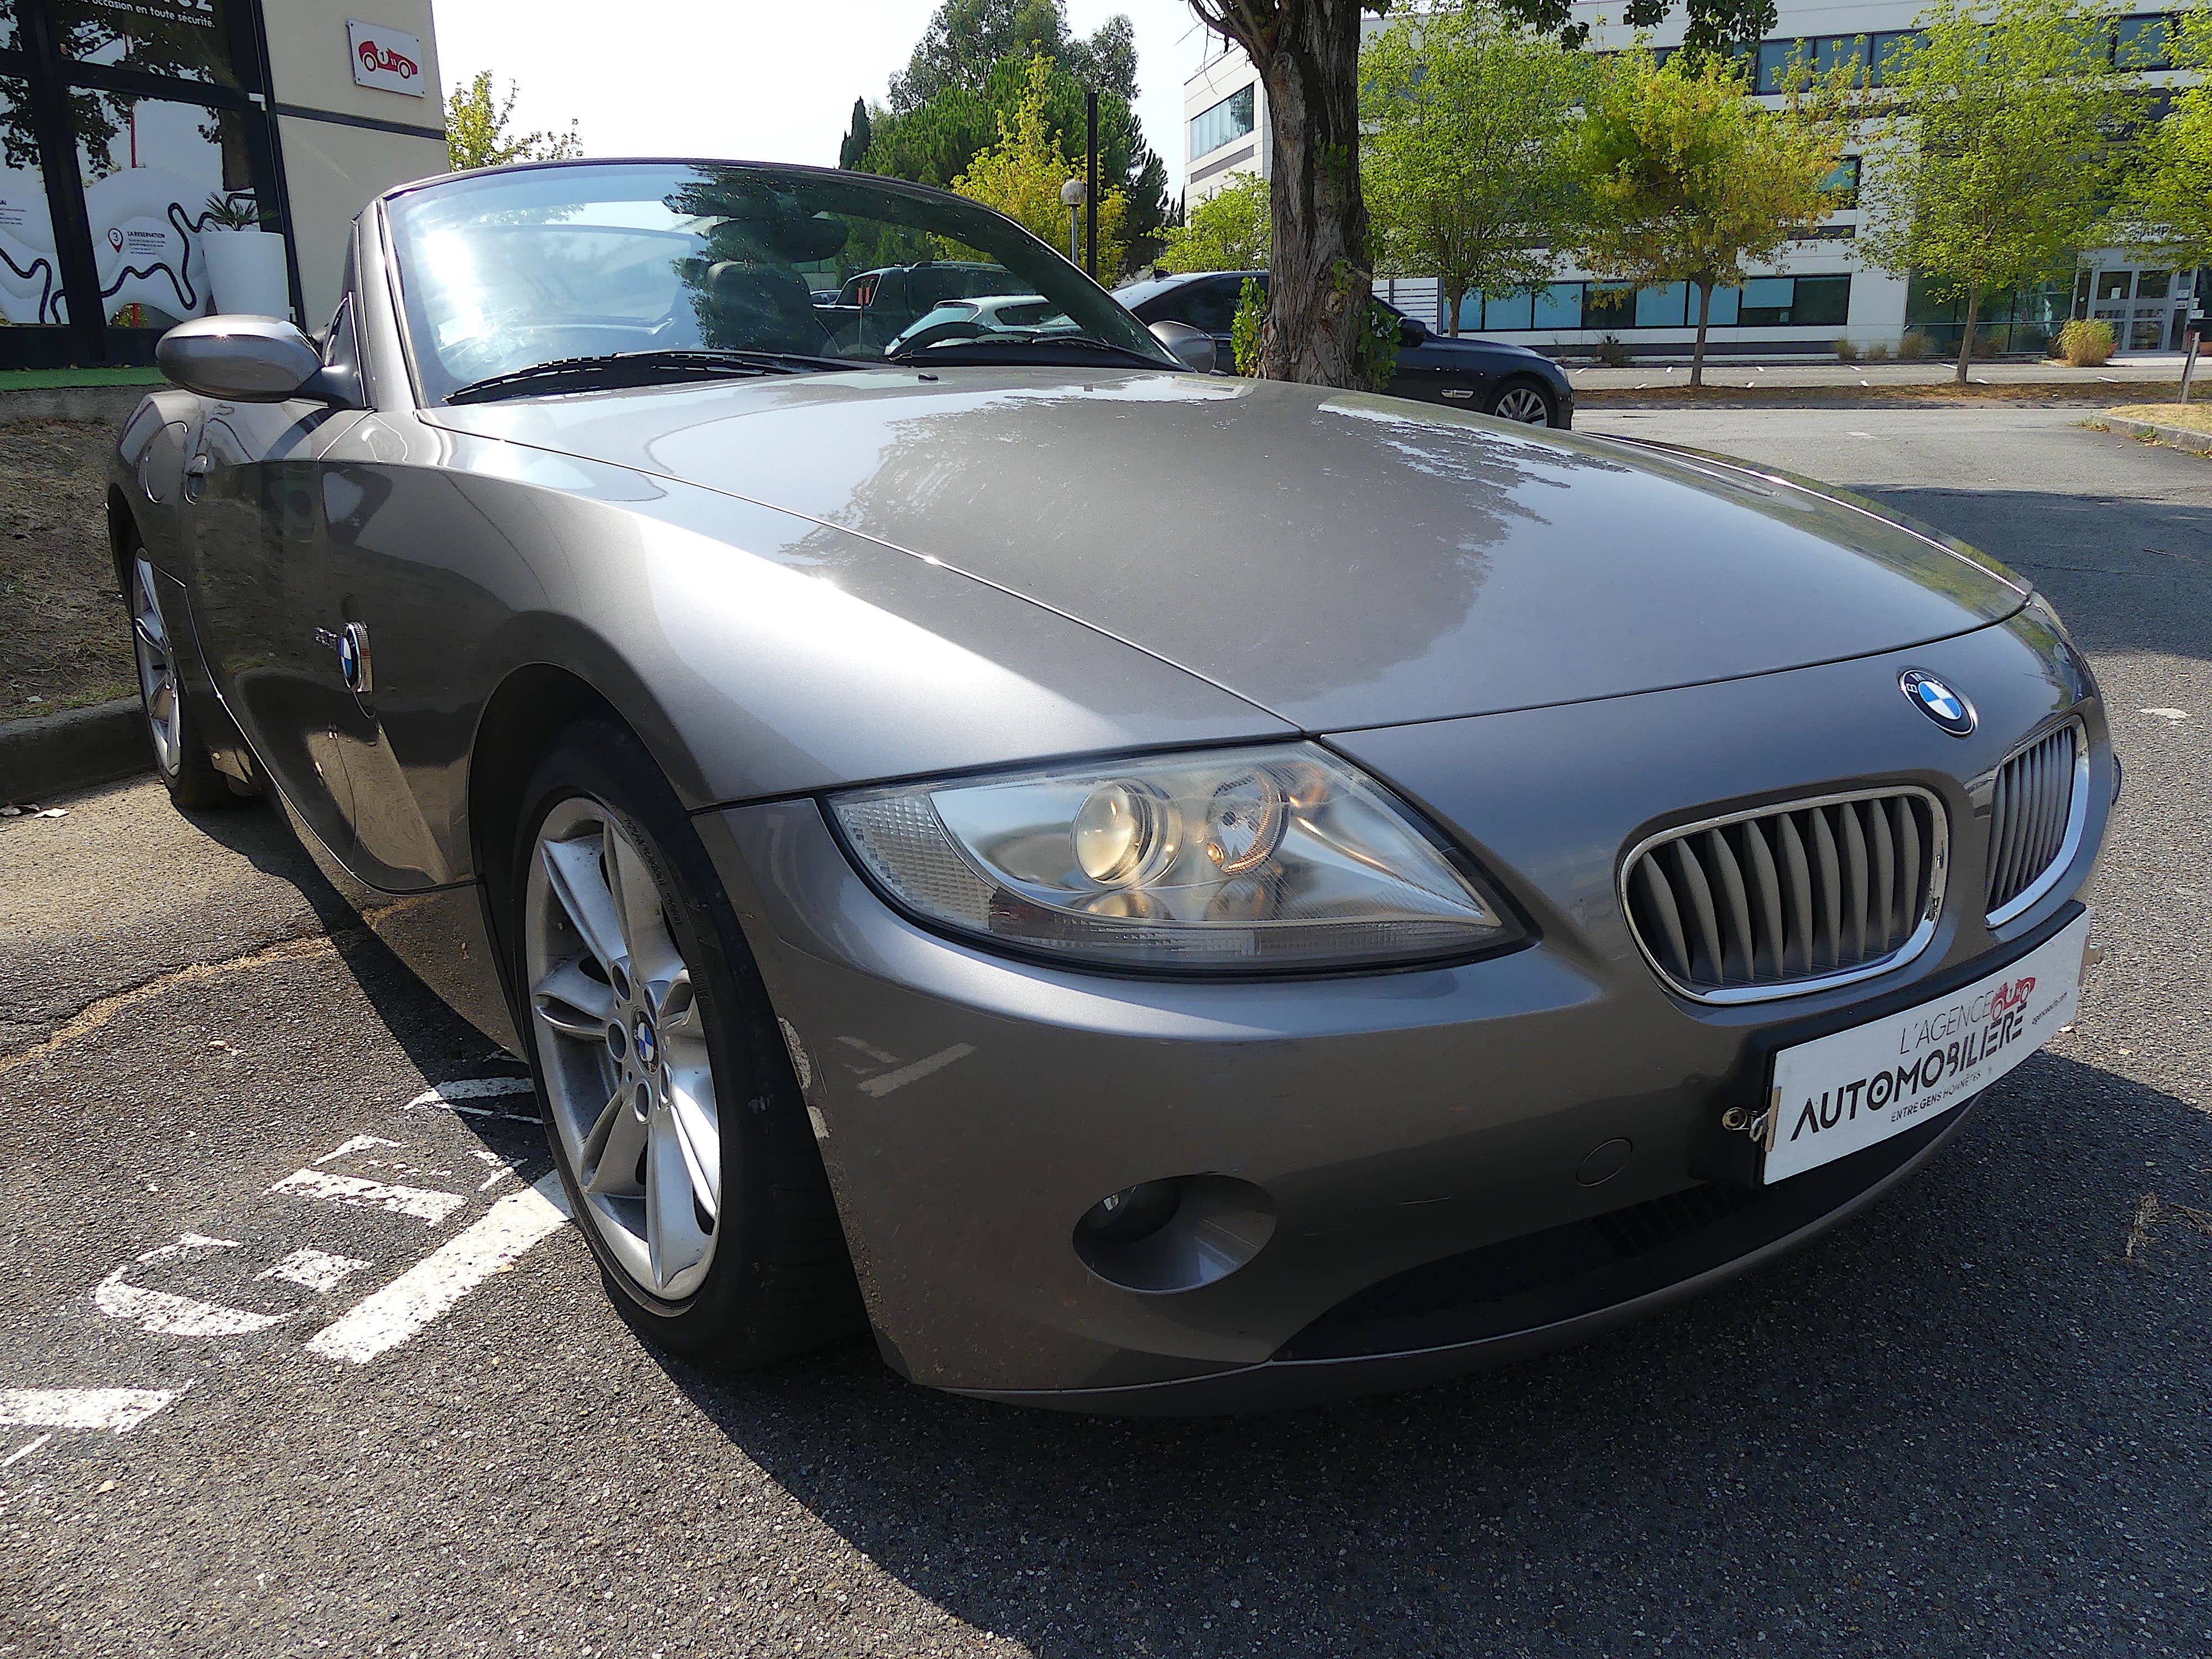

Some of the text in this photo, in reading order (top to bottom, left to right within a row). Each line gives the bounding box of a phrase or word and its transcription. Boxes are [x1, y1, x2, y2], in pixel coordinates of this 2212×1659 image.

[92, 0, 133, 11] occasion
[135, 5, 148, 14] en
[150, 6, 175, 20] toute
[113, 232, 119, 242] 3
[1906, 673, 1943, 694] BMW
[1891, 1104, 1918, 1123] ENTRE
[1919, 1092, 1942, 1110] GENS
